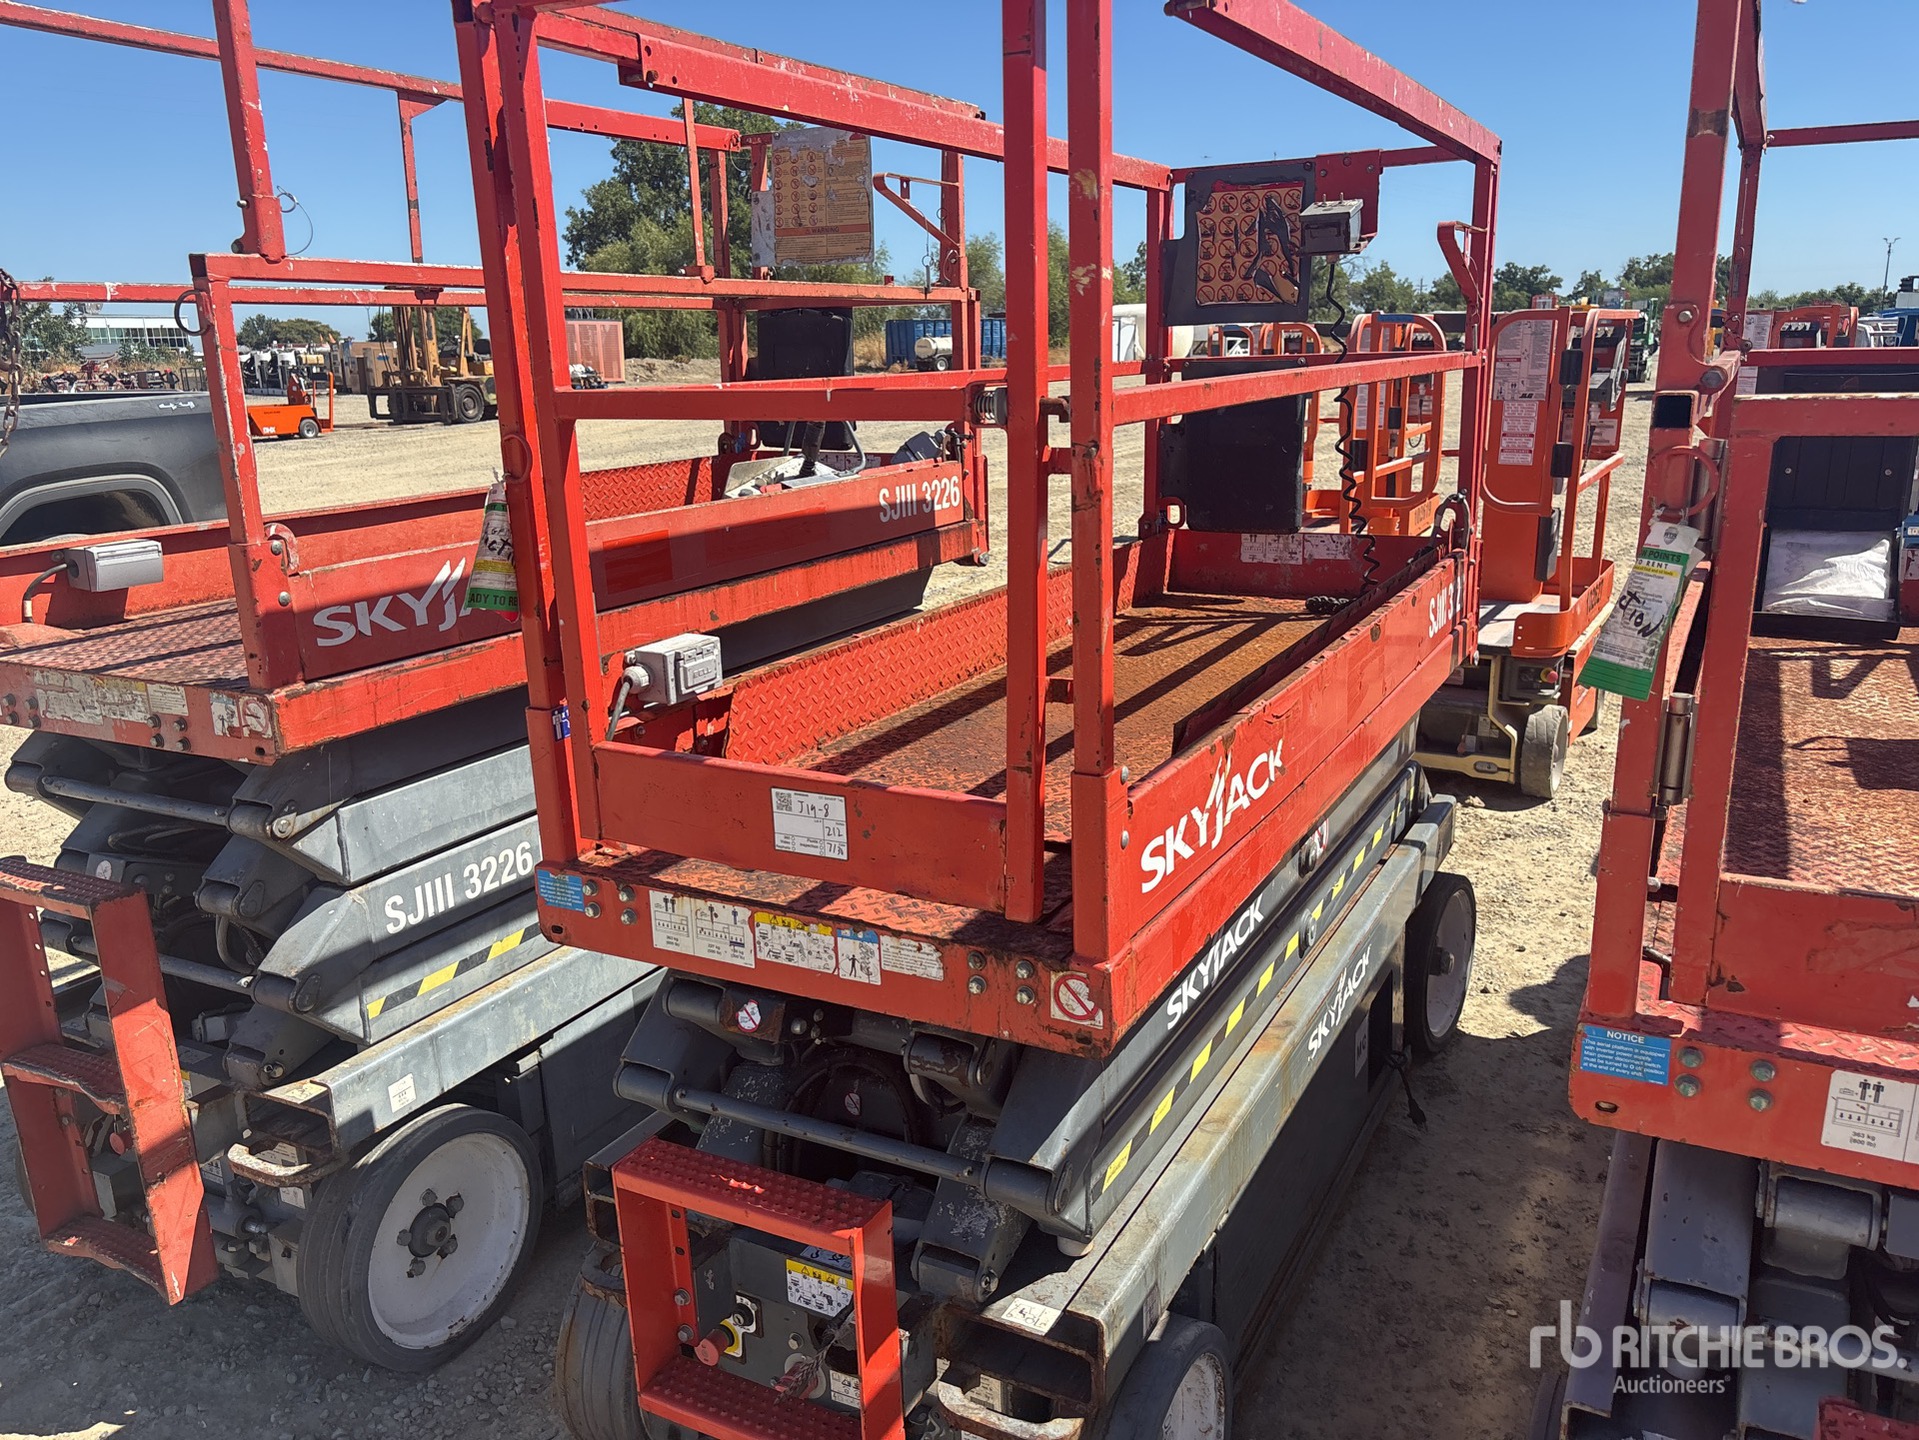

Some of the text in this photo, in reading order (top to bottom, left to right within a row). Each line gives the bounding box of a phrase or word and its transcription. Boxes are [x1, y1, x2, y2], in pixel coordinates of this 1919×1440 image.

[879, 475, 960, 522] SJIII 3226
[1648, 549, 1681, 563] POINTS
[1646, 560, 1668, 570] RENT
[493, 594, 506, 606] TO
[1140, 738, 1285, 894] SKYJACK
[385, 872, 455, 934] SJIII
[463, 841, 533, 900] 3226
[1167, 893, 1264, 1030] SKYJACK
[1607, 1031, 1645, 1044] NOTICE
[1612, 1044, 1633, 1052] platform
